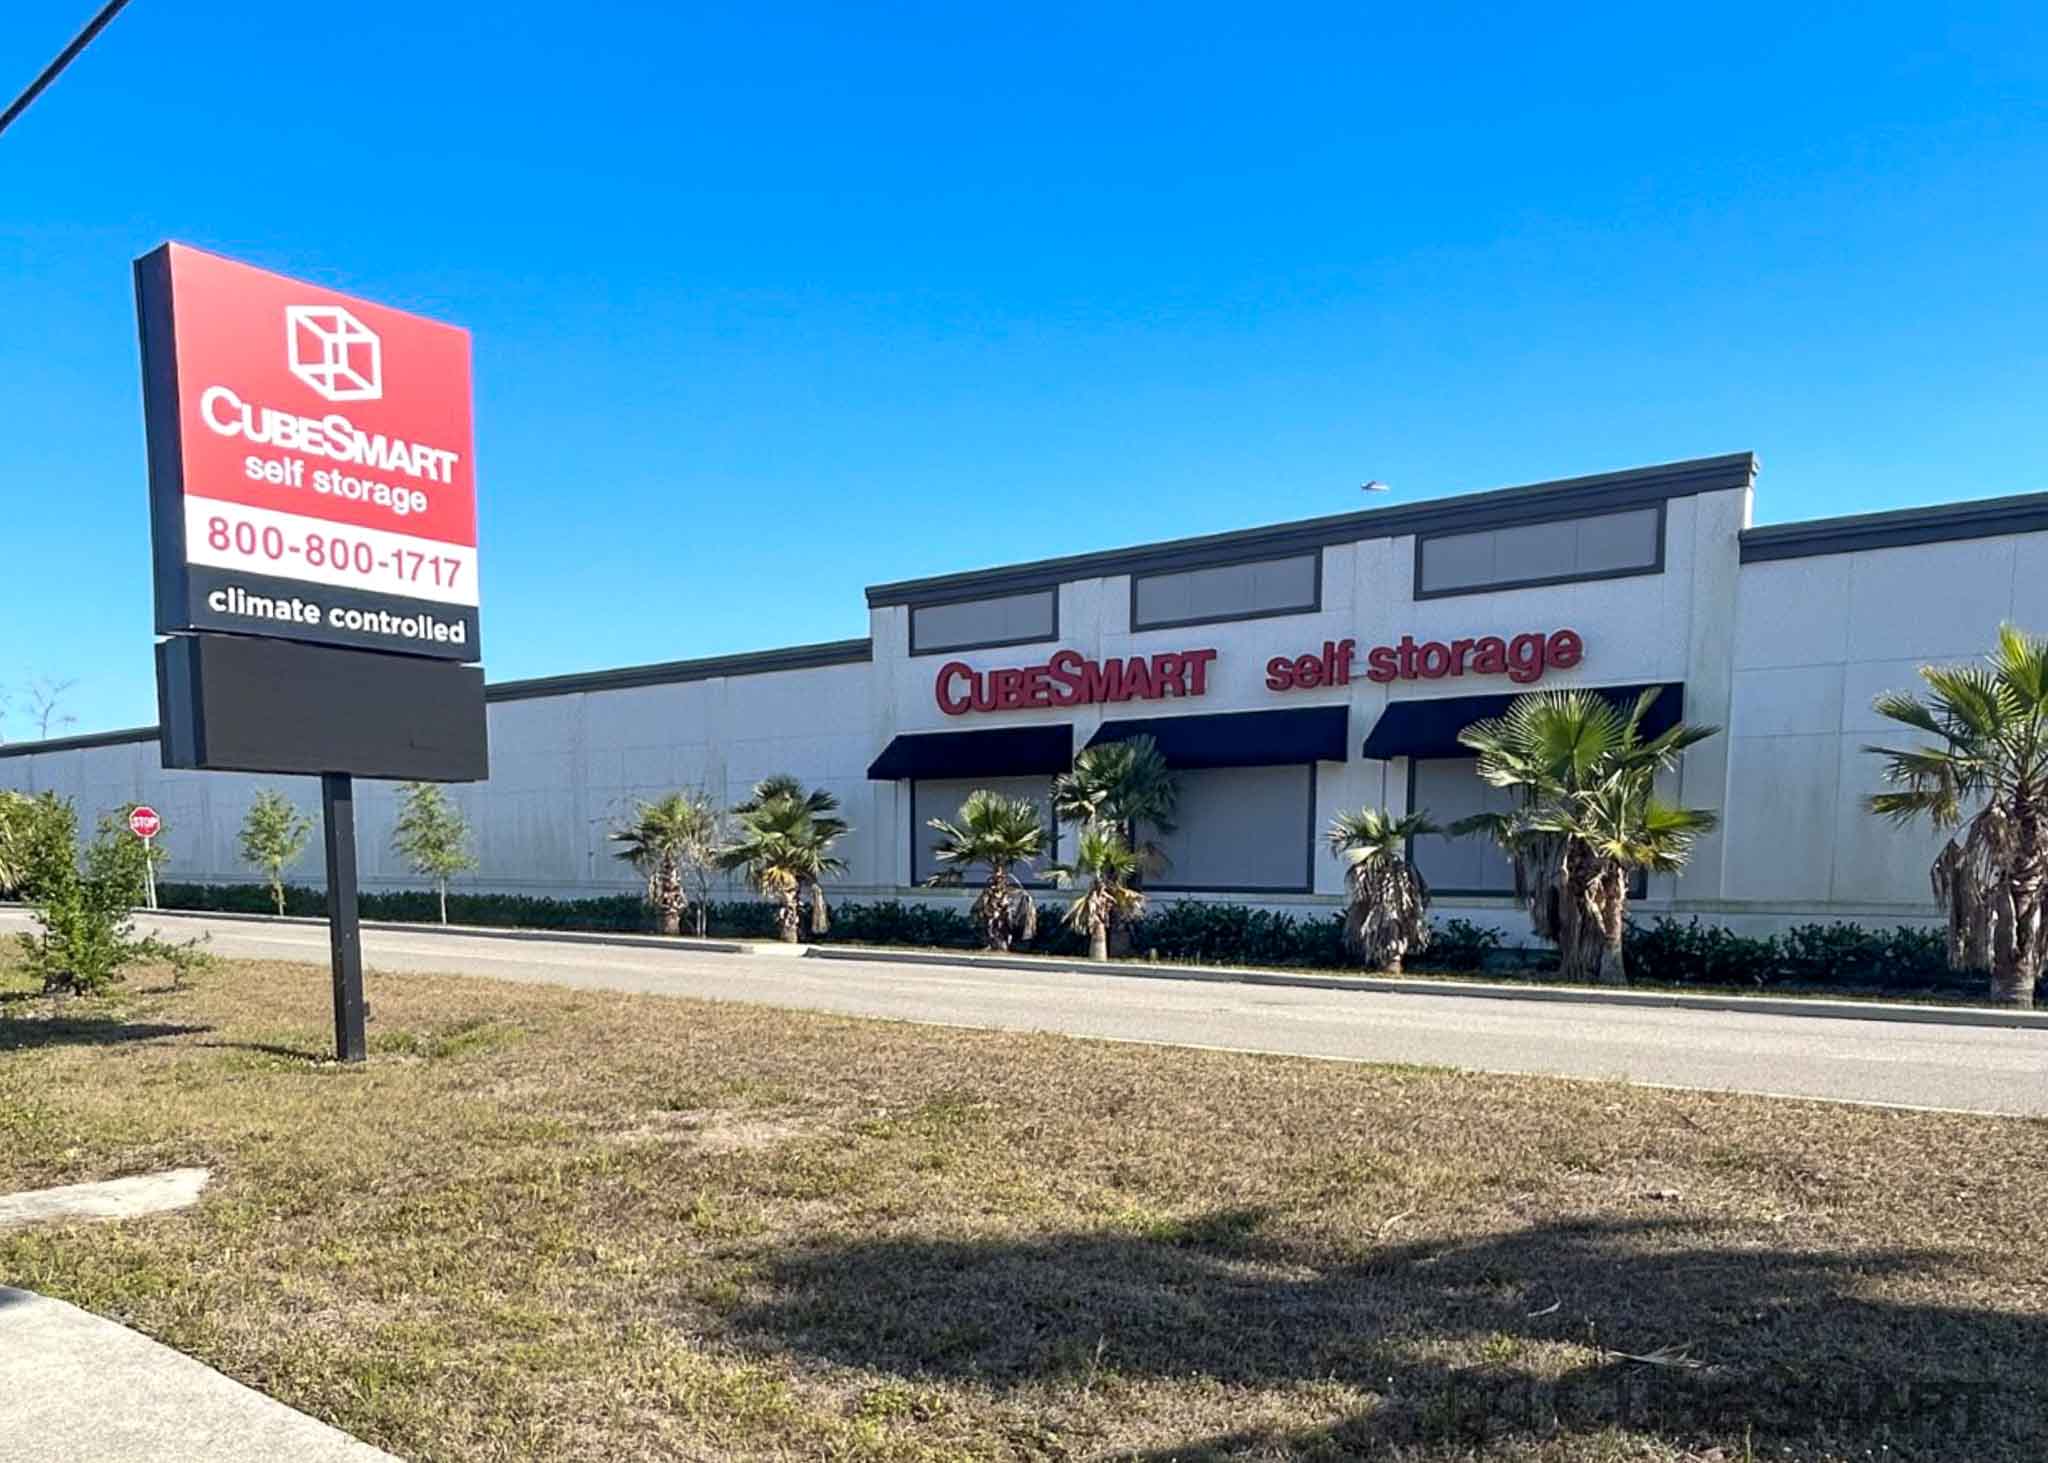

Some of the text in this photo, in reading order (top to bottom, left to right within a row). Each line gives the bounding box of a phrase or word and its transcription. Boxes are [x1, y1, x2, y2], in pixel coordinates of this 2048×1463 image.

[201, 386, 459, 483] CUBESMART
[245, 455, 428, 515] self storage
[208, 516, 461, 588] 800-800-1717
[208, 587, 466, 643] climate controlled
[935, 629, 1583, 715] CUBESMART self storage
[131, 815, 158, 829] STOP
